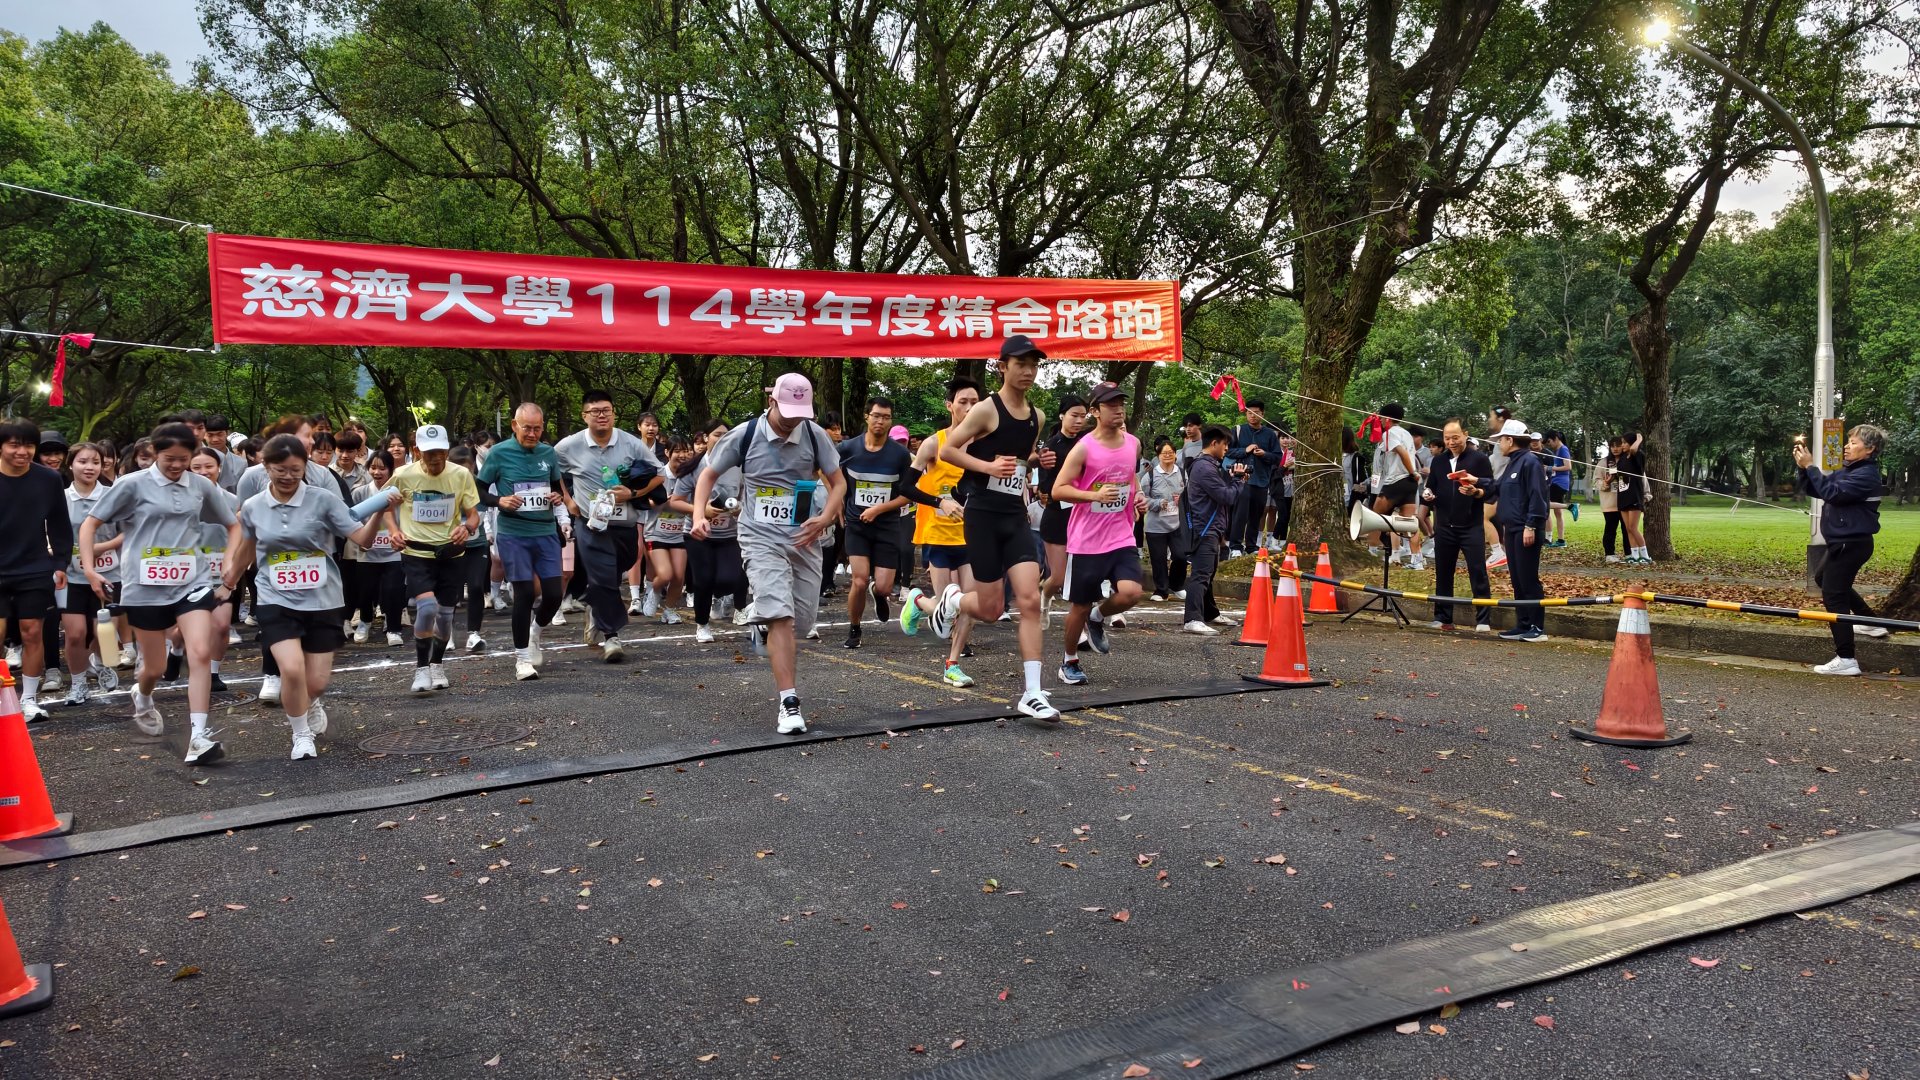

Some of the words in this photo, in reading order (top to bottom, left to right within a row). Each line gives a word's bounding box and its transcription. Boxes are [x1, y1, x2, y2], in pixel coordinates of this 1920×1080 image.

[240, 262, 1164, 341] 慈濟大學114學年度精舍路跑
[860, 494, 886, 504] 1071
[419, 508, 446, 518] 9004
[147, 566, 190, 580] 5307
[277, 569, 320, 585] 5310
